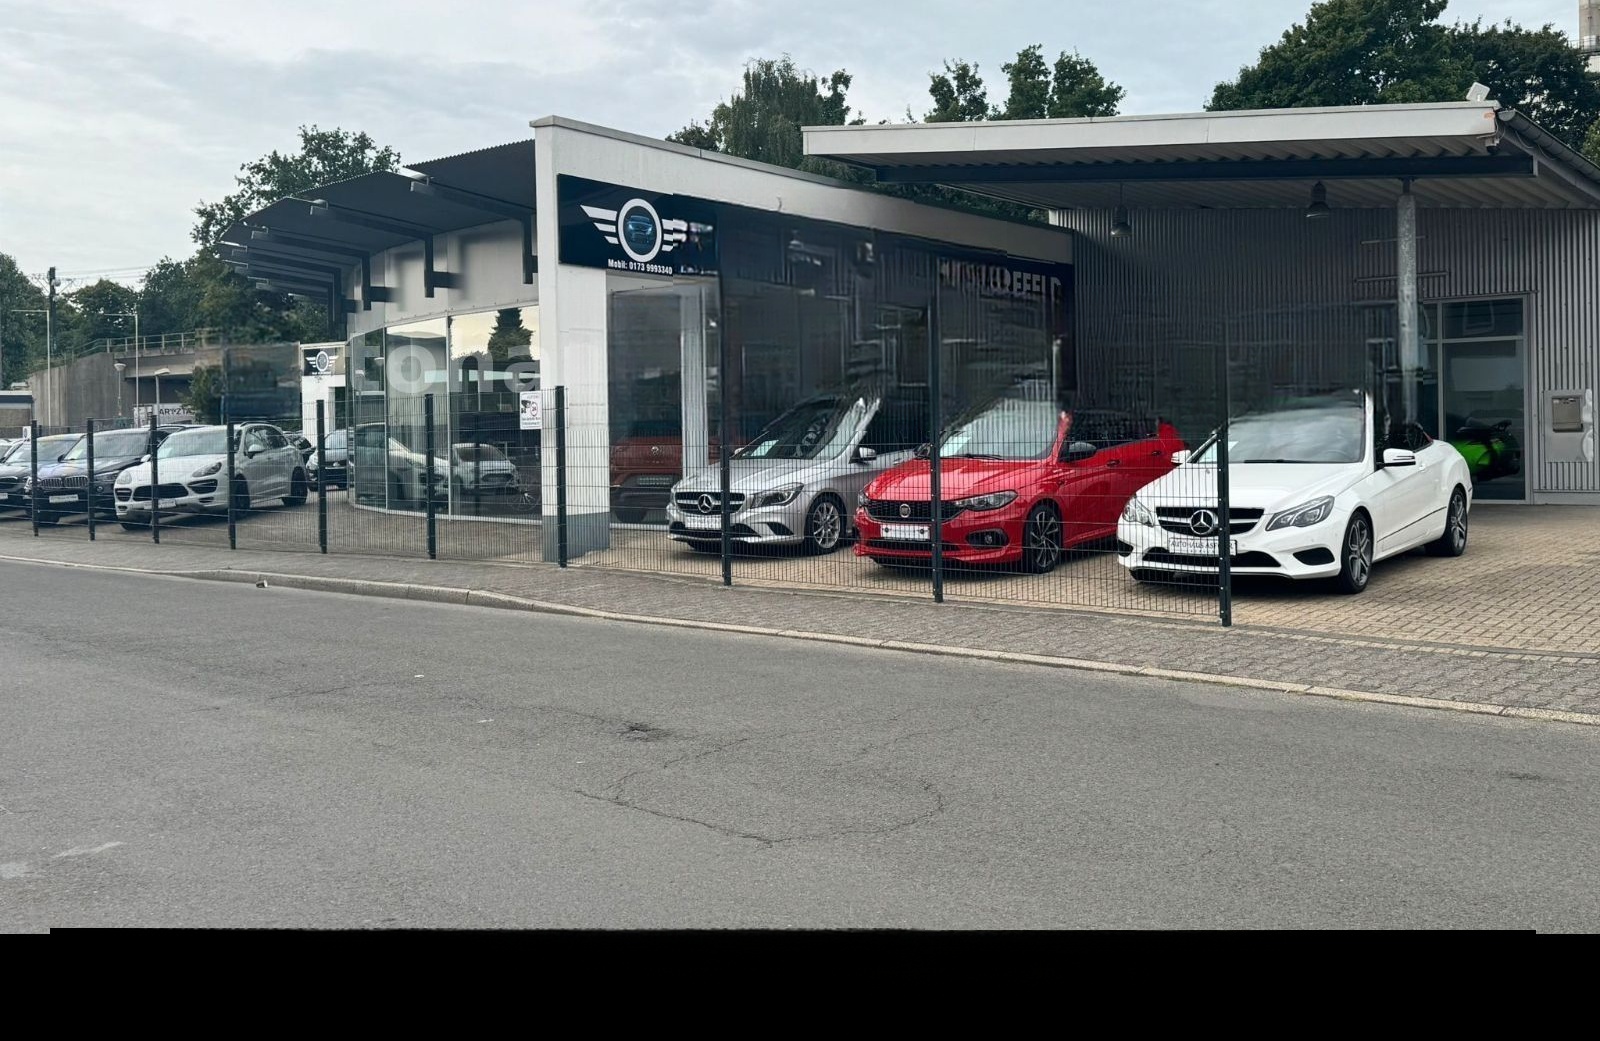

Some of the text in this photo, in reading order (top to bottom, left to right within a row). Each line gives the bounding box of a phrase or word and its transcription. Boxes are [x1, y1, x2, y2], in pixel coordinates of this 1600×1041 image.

[607, 258, 628, 268] Mobil:
[629, 261, 646, 272] 0173
[646, 264, 673, 275] 9993340
